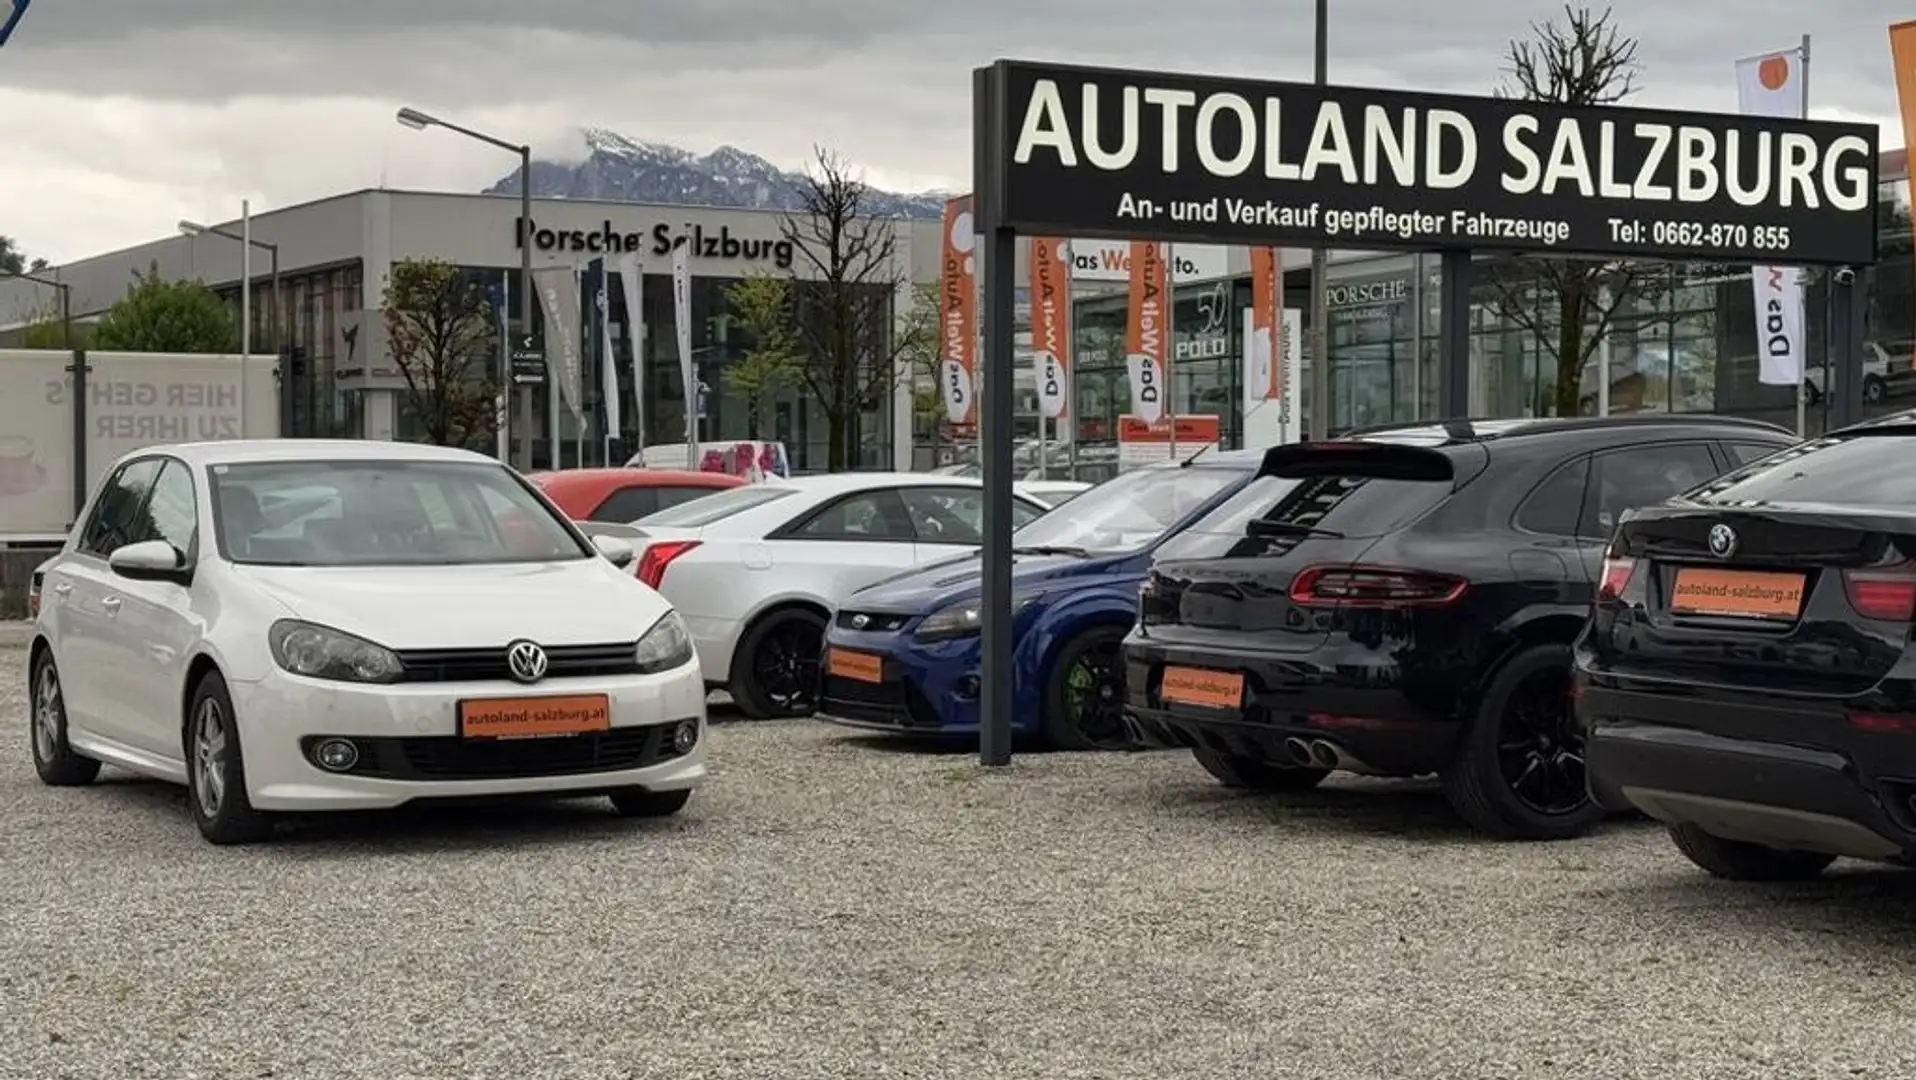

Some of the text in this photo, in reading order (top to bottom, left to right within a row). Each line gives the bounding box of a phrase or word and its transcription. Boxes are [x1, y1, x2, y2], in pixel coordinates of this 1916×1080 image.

[1013, 79, 1870, 212] AUTOLAND SALZBURG
[1117, 193, 1570, 243] An- und Verkauf gepflegter Fahrzeuge
[516, 217, 640, 254] Porsche
[1608, 219, 1790, 249] Tel: 0662-870 855
[1071, 252, 1098, 271] as
[1326, 279, 1407, 307] PORSCHE
[1176, 339, 1226, 360] POLO
[1676, 582, 1801, 604] autoland-salzburg.at
[466, 707, 605, 726] autoland-salzburg.at
